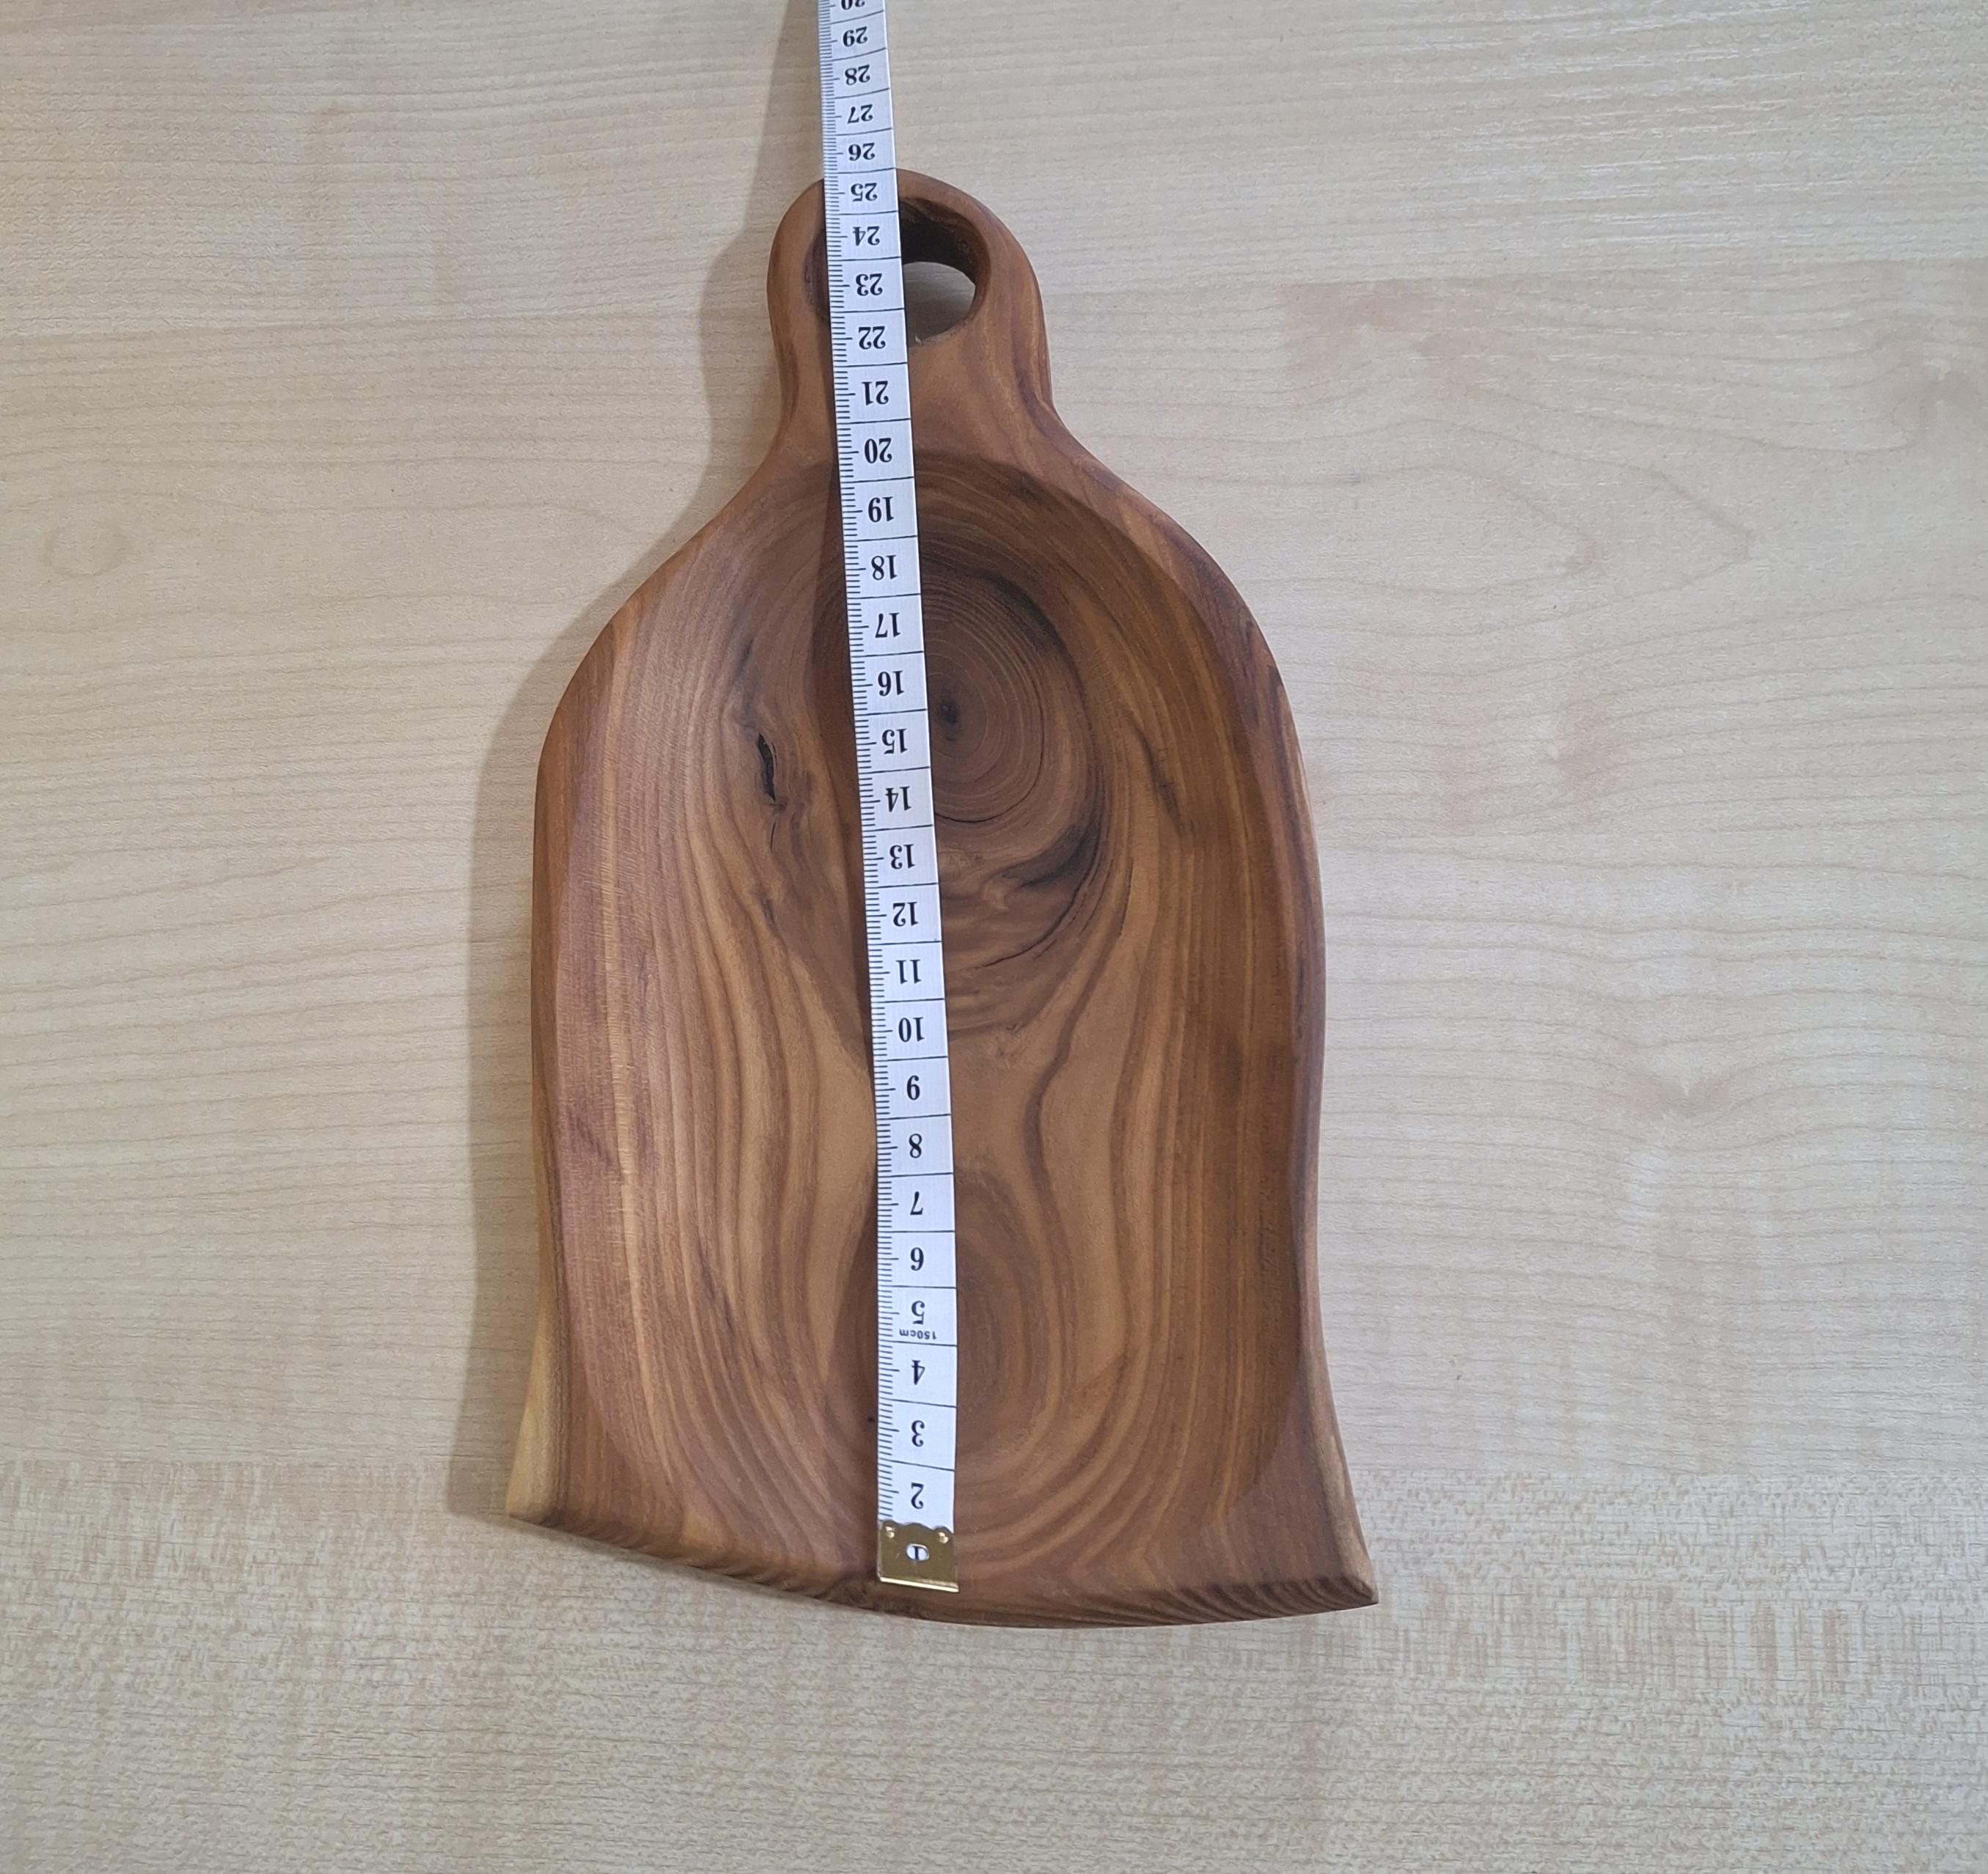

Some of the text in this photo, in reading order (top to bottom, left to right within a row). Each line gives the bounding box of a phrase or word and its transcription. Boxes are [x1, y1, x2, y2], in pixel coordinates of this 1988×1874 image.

[843, 26, 868, 47] 29
[845, 65, 870, 85] 28
[848, 104, 873, 123] 27
[848, 143, 876, 161] 26
[851, 183, 878, 202] 25
[854, 227, 880, 246] 24
[856, 273, 883, 295] 23
[859, 326, 886, 349] 22
[862, 381, 889, 405] 21
[865, 438, 892, 463] 20
[868, 497, 894, 522] 19
[871, 555, 897, 580] 18
[876, 613, 901, 638] 17
[878, 671, 904, 696] 16
[882, 729, 908, 754] 15
[886, 787, 912, 812] 14
[890, 845, 915, 869] 13
[893, 902, 918, 926] 12
[898, 960, 921, 984] 11
[899, 1018, 924, 1042] 10
[907, 1076, 920, 1100] 9
[909, 1133, 923, 1158] 8
[911, 1191, 924, 1216] 7
[911, 1248, 924, 1271] 6
[912, 1301, 925, 1324] 5
[899, 1329, 937, 1340] 150cm
[912, 1360, 925, 1385] 4
[912, 1420, 925, 1447] 3
[911, 1482, 924, 1509] 2
